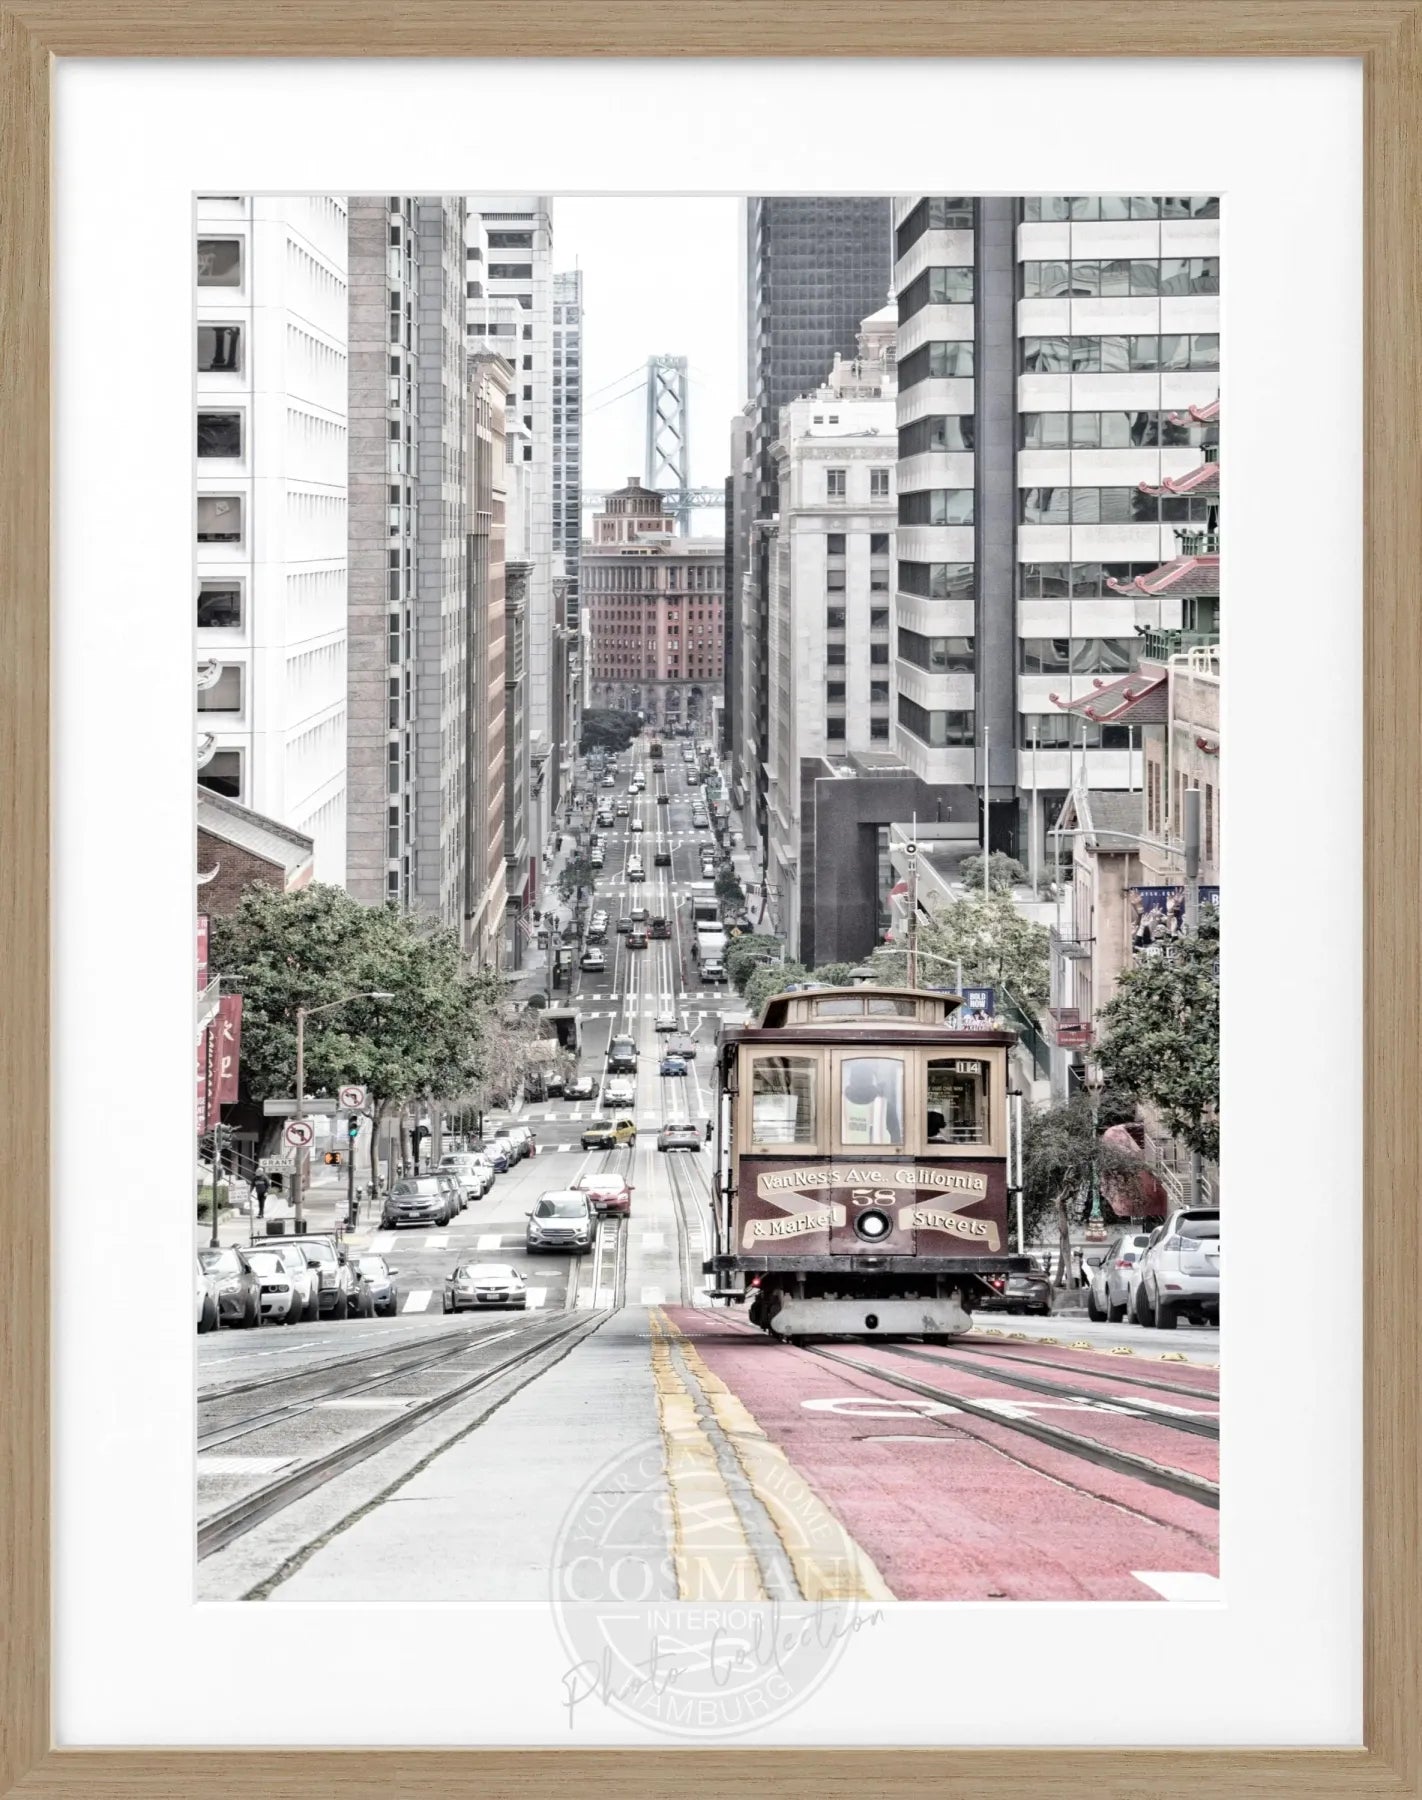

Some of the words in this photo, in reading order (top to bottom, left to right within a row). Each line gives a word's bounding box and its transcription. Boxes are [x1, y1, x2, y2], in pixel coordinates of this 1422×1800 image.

[969, 1000, 986, 1008] NOW
[894, 1167, 984, 1190] California
[851, 1189, 896, 1206] 58
[753, 1221, 766, 1236] &
[769, 1209, 839, 1236] Market
[911, 1210, 988, 1236] Streets
